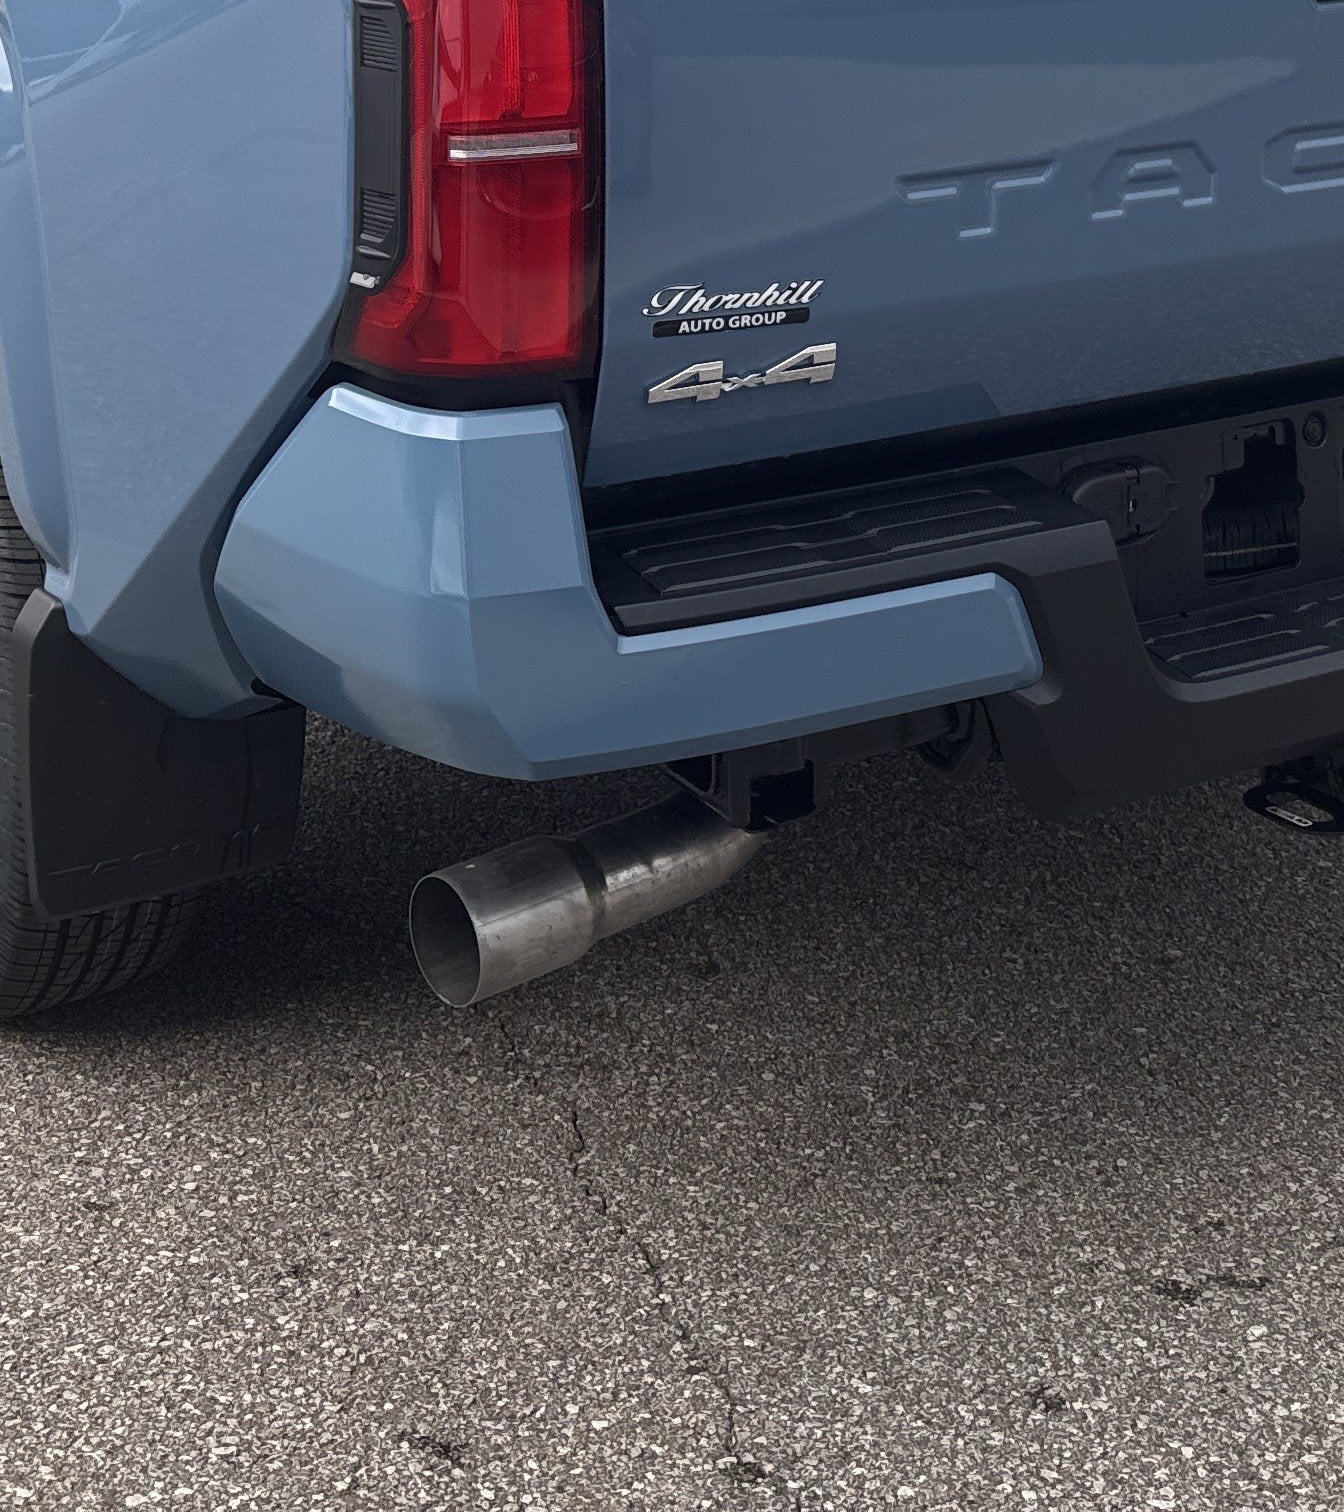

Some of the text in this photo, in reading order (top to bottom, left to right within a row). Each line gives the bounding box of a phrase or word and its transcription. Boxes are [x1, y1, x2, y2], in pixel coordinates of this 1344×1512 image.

[641, 279, 825, 317] Thornhill
[677, 310, 788, 335] AUTO GROUP
